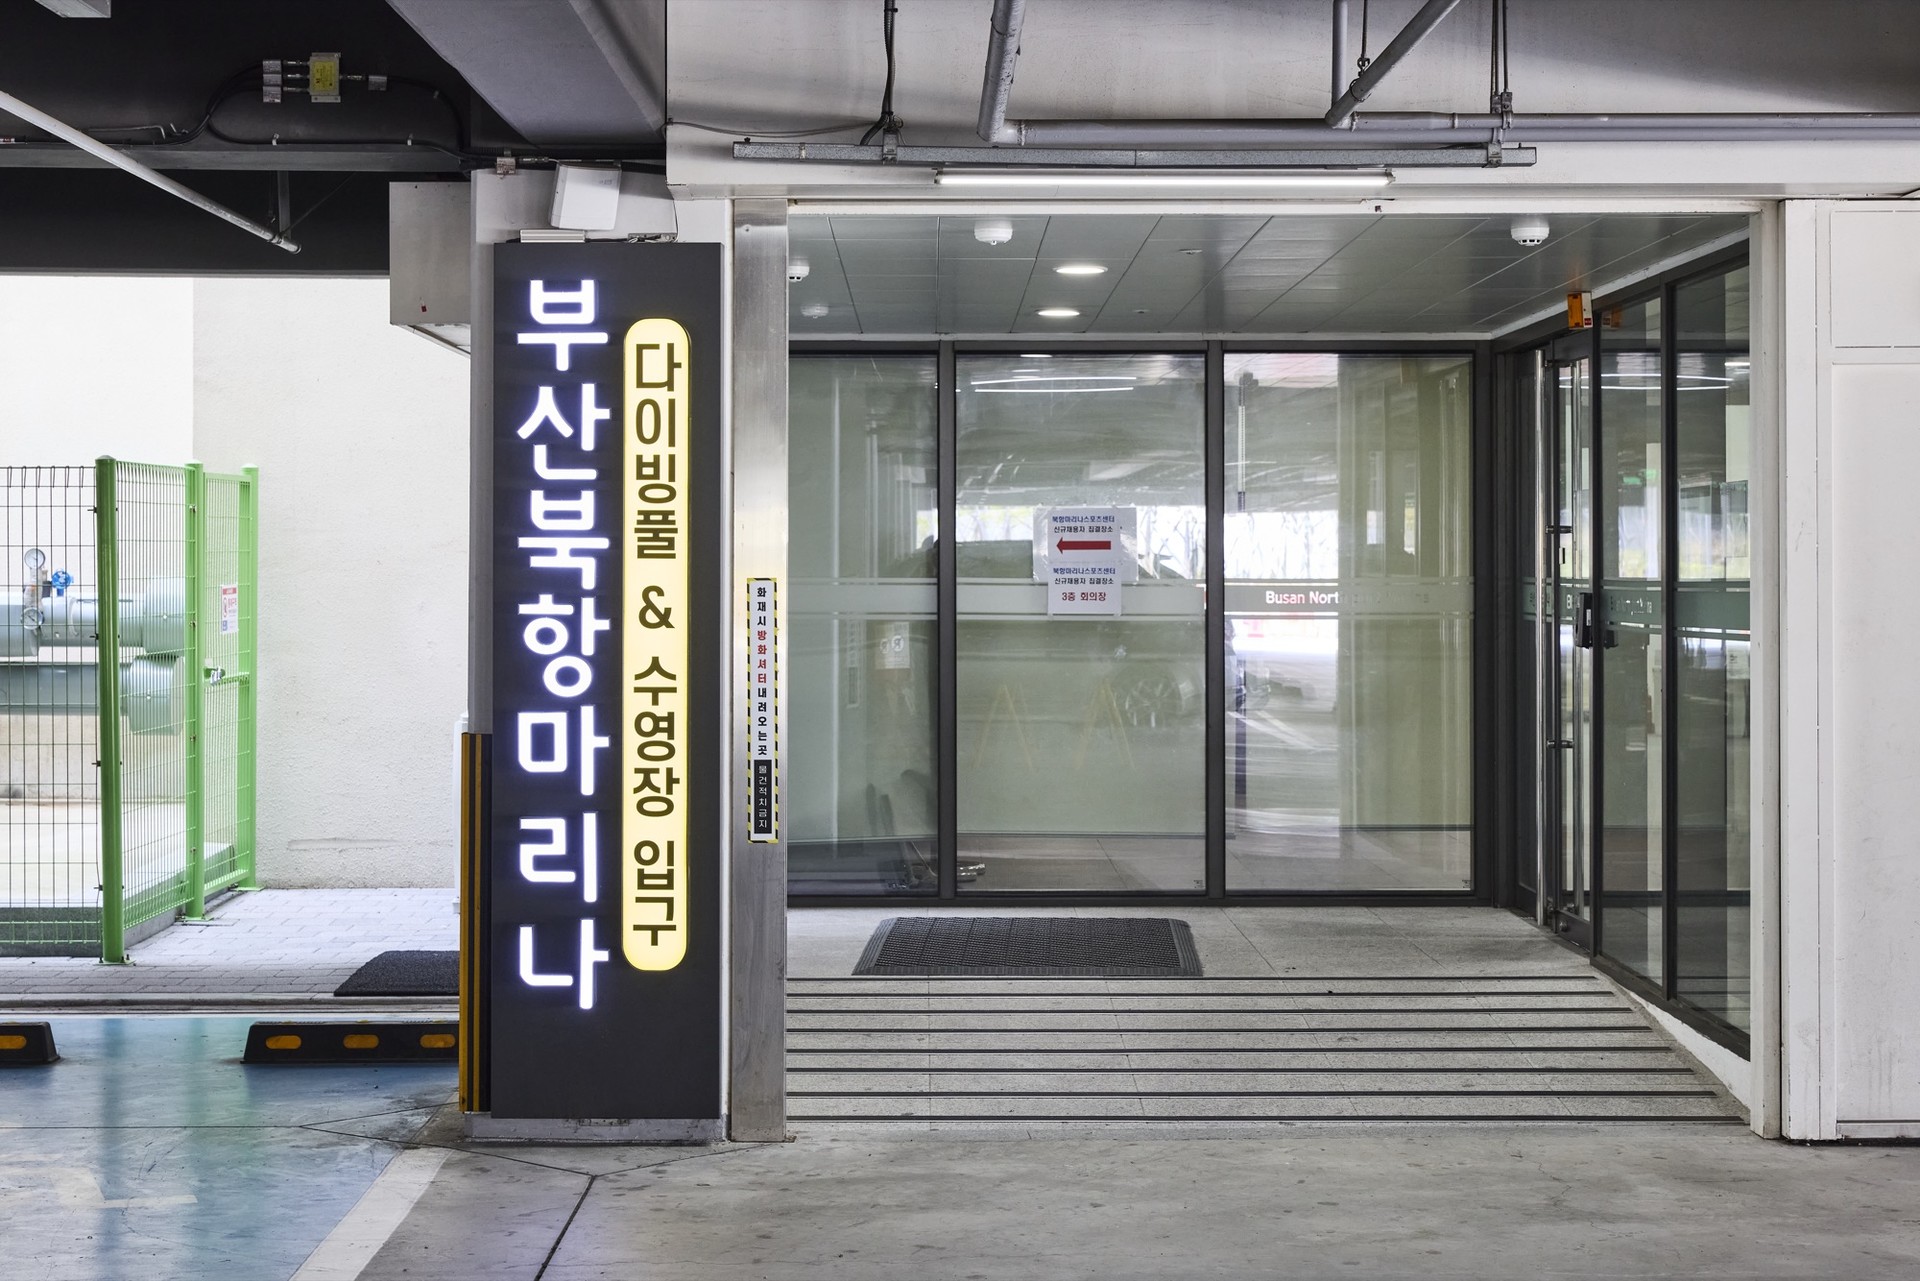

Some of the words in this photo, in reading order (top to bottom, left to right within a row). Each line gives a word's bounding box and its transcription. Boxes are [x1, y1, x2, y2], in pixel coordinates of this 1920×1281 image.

[633, 342, 682, 560] 다이빙풀
[517, 279, 611, 1010] 부산북항마리나
[638, 585, 676, 630] &
[1061, 591, 1076, 602] 3층
[1080, 591, 1107, 602] 회의장
[1265, 590, 1305, 604] Busan
[632, 656, 681, 818] 수영장
[632, 840, 678, 947] 입구
